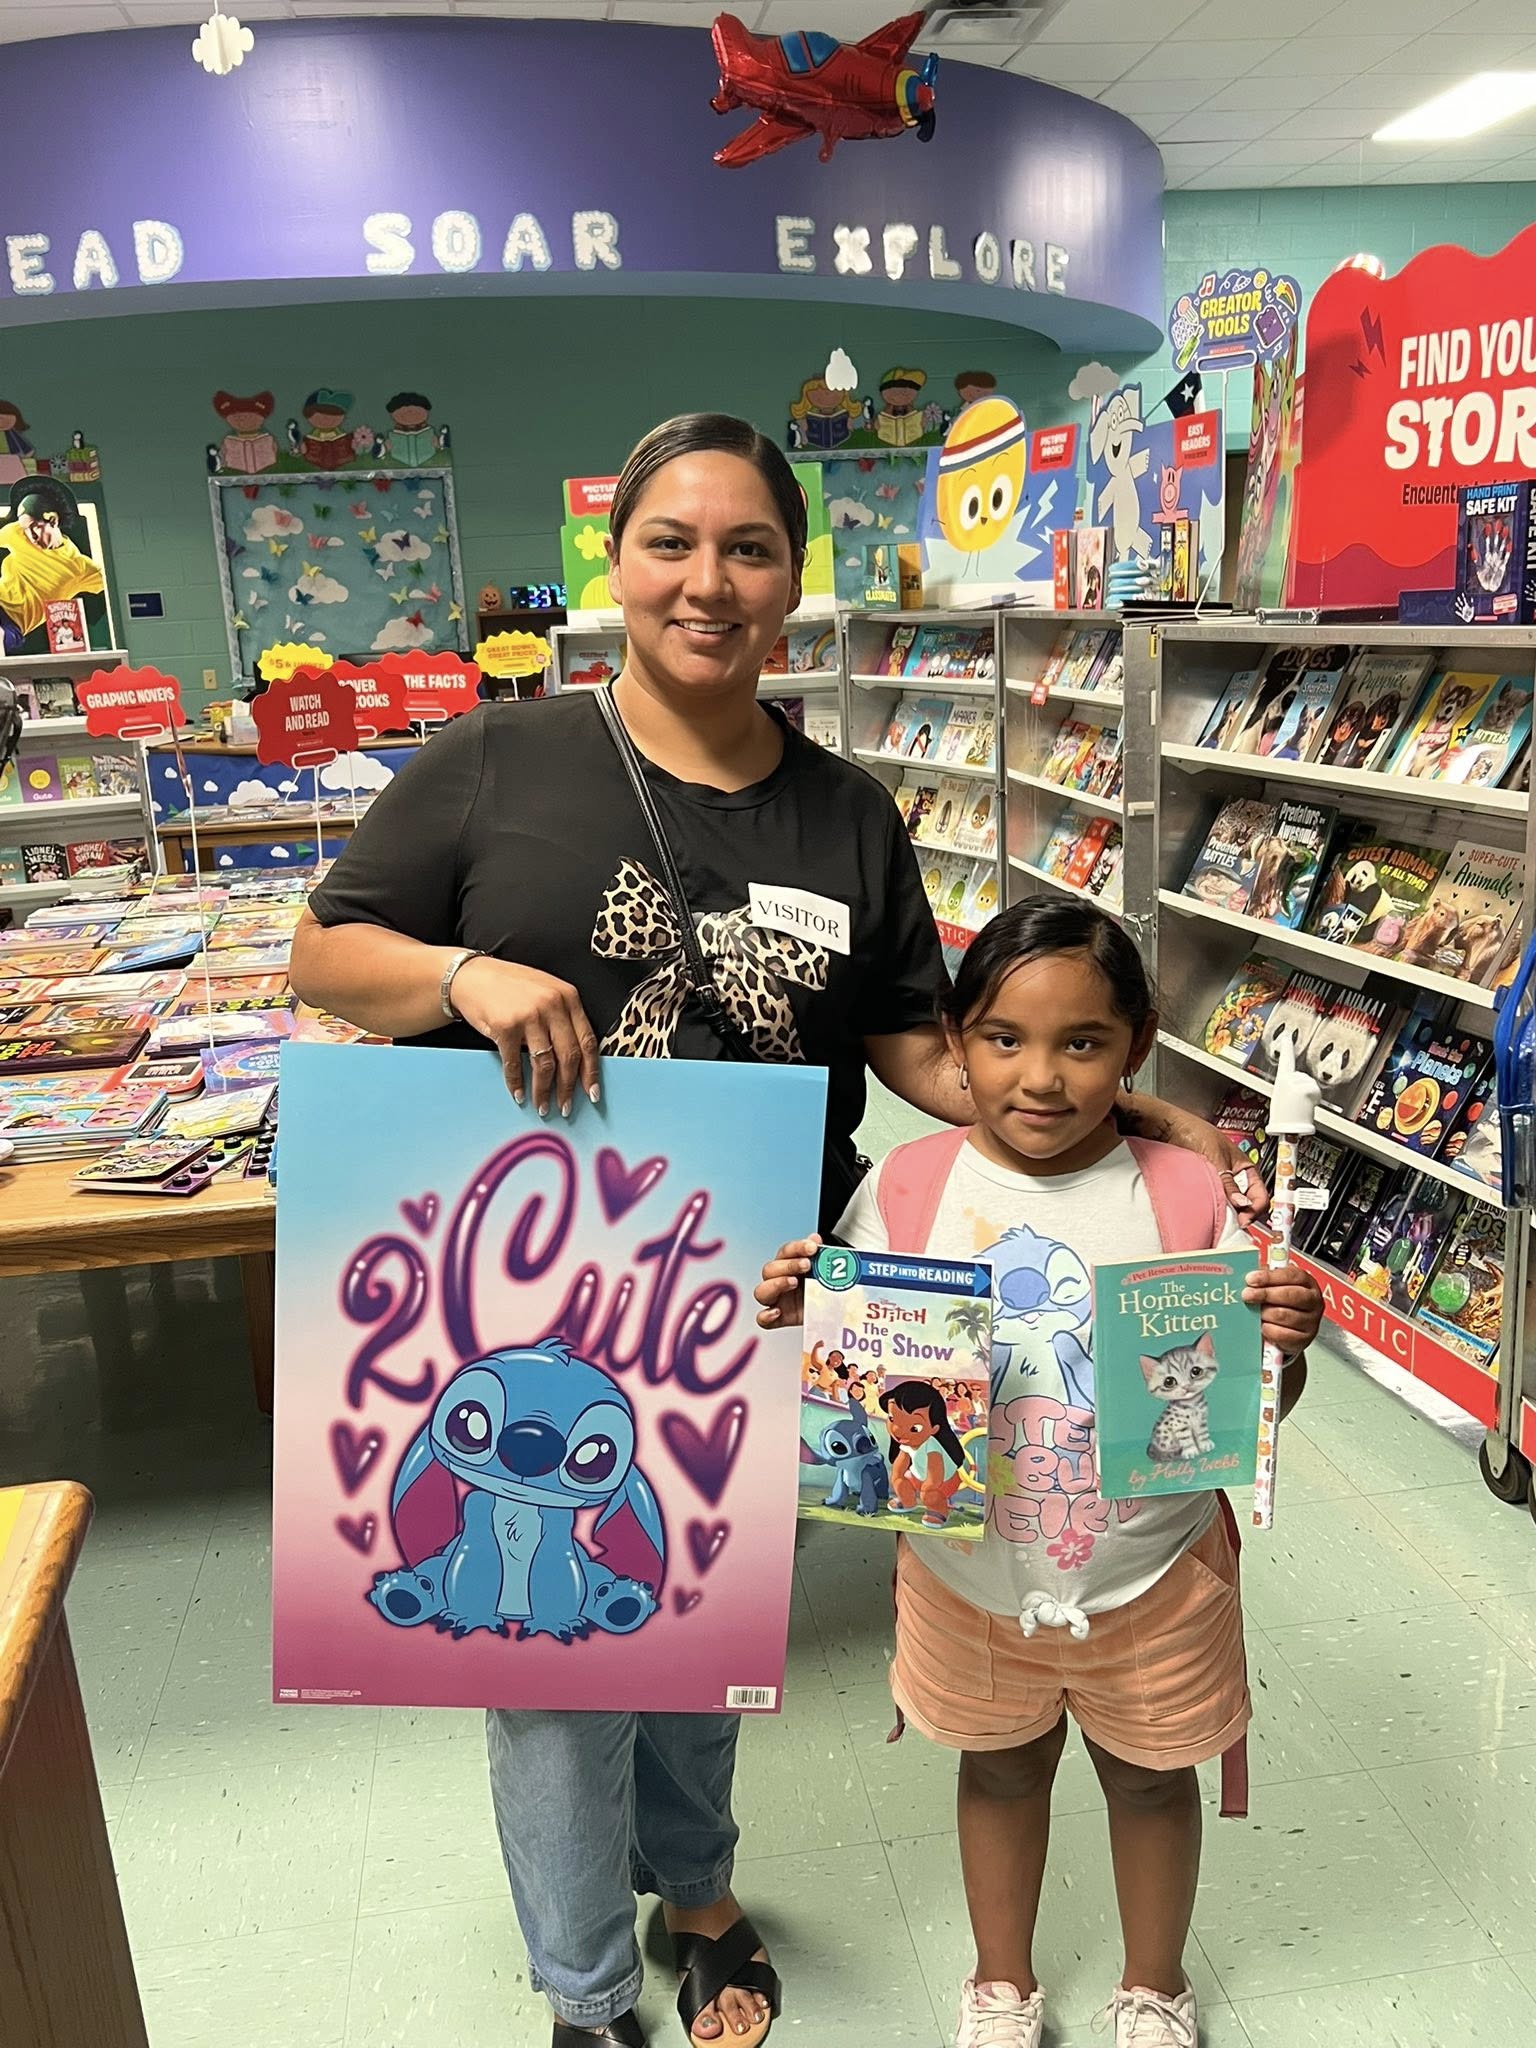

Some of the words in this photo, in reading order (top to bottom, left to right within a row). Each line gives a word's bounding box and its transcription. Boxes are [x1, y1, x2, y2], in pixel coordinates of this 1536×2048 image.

[362, 211, 622, 274] SOAR
[776, 216, 1069, 293] EXPLORE
[1200, 290, 1262, 319] CREATOR
[1208, 314, 1250, 339] TOOLS
[1400, 327, 1471, 389] FIND
[1467, 487, 1490, 499] HAND
[1492, 484, 1518, 497] PRINT
[1466, 498, 1495, 515] SAFE
[1498, 496, 1517, 512] KIT
[1283, 646, 1335, 669] DOGS
[403, 674, 426, 689] THE
[428, 674, 467, 689] FACTS
[87, 689, 137, 709] GRAPHIC
[289, 693, 321, 713] WATCH
[356, 694, 390, 708] OOKS
[285, 715, 305, 732] AND
[305, 711, 330, 730] READ
[1473, 728, 1510, 744] KITTENS
[1279, 802, 1321, 826] Predators
[25, 846, 55, 857] LIONEL
[28, 854, 56, 864] MESSI
[73, 844, 103, 854] SHOHEI
[75, 852, 105, 863] OHTANI
[1202, 848, 1238, 868] BATTLES
[1468, 849, 1520, 870] SUPER-CUTE
[1347, 847, 1391, 862] CUTEST
[1389, 849, 1438, 881] ANIMALS
[1405, 872, 1429, 892] TIME!
[1453, 862, 1514, 899] Animals
[758, 900, 839, 938] VISITOR
[1411, 1050, 1463, 1086] Planets
[1216, 1118, 1259, 1131] RAINBOW
[342, 1234, 436, 1410] 2
[441, 1130, 760, 1396] Cute
[831, 1257, 848, 1280] 2
[868, 1262, 898, 1277] STEP
[898, 1268, 918, 1278] INTO
[918, 1267, 975, 1285] READING
[1132, 1271, 1147, 1282] Pet
[1148, 1267, 1176, 1278] Rescue
[1178, 1264, 1223, 1274] Adventures
[1161, 1281, 1185, 1294] The
[1118, 1282, 1238, 1315] Homesick
[863, 1322, 889, 1337] The
[1139, 1312, 1219, 1339] Kitten
[841, 1327, 883, 1358] Dog
[892, 1333, 955, 1361] Show
[1128, 1470, 1147, 1492] by
[1150, 1462, 1197, 1484] Holly
